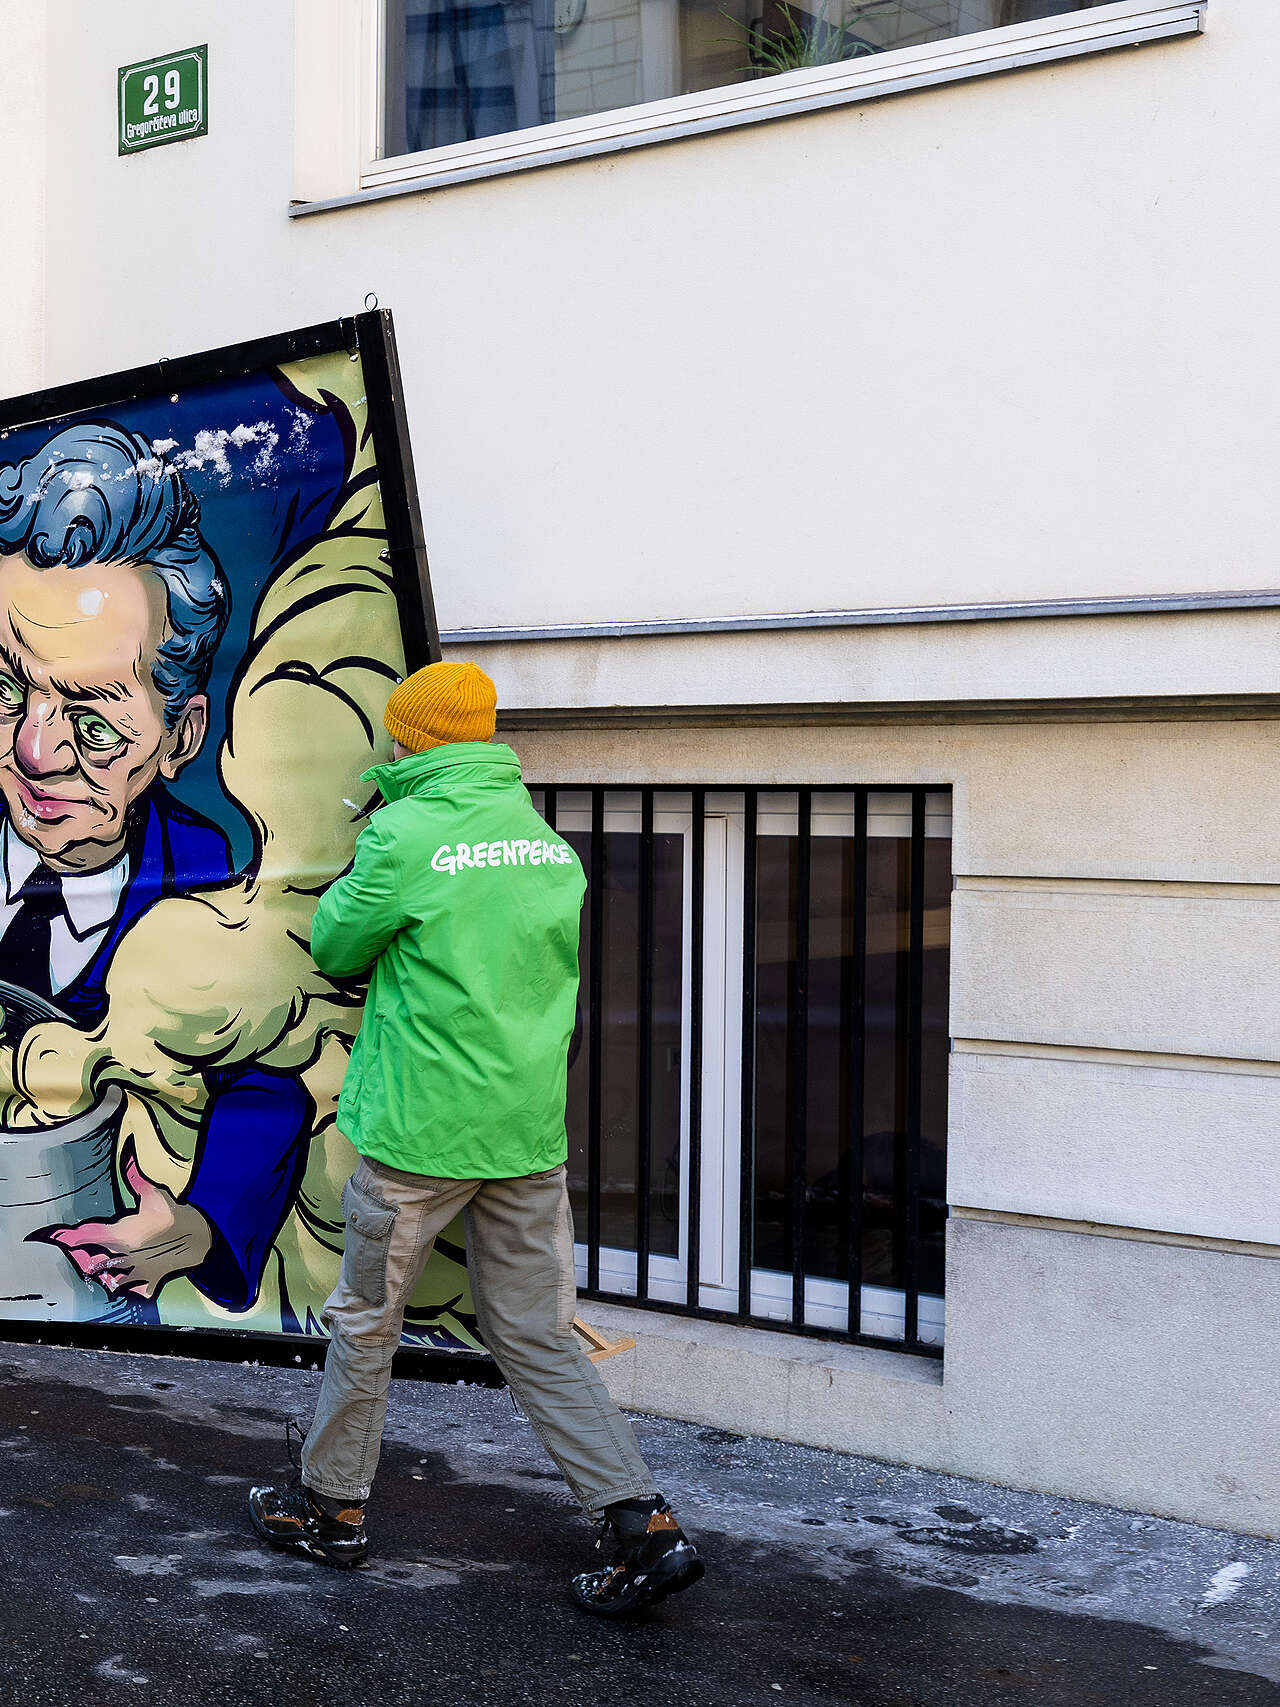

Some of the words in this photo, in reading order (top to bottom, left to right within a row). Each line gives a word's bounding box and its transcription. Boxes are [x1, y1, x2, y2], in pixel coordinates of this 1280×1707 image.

[143, 69, 180, 116] 29
[178, 108, 198, 125] ulica
[430, 839, 573, 876] GREENPEACE
